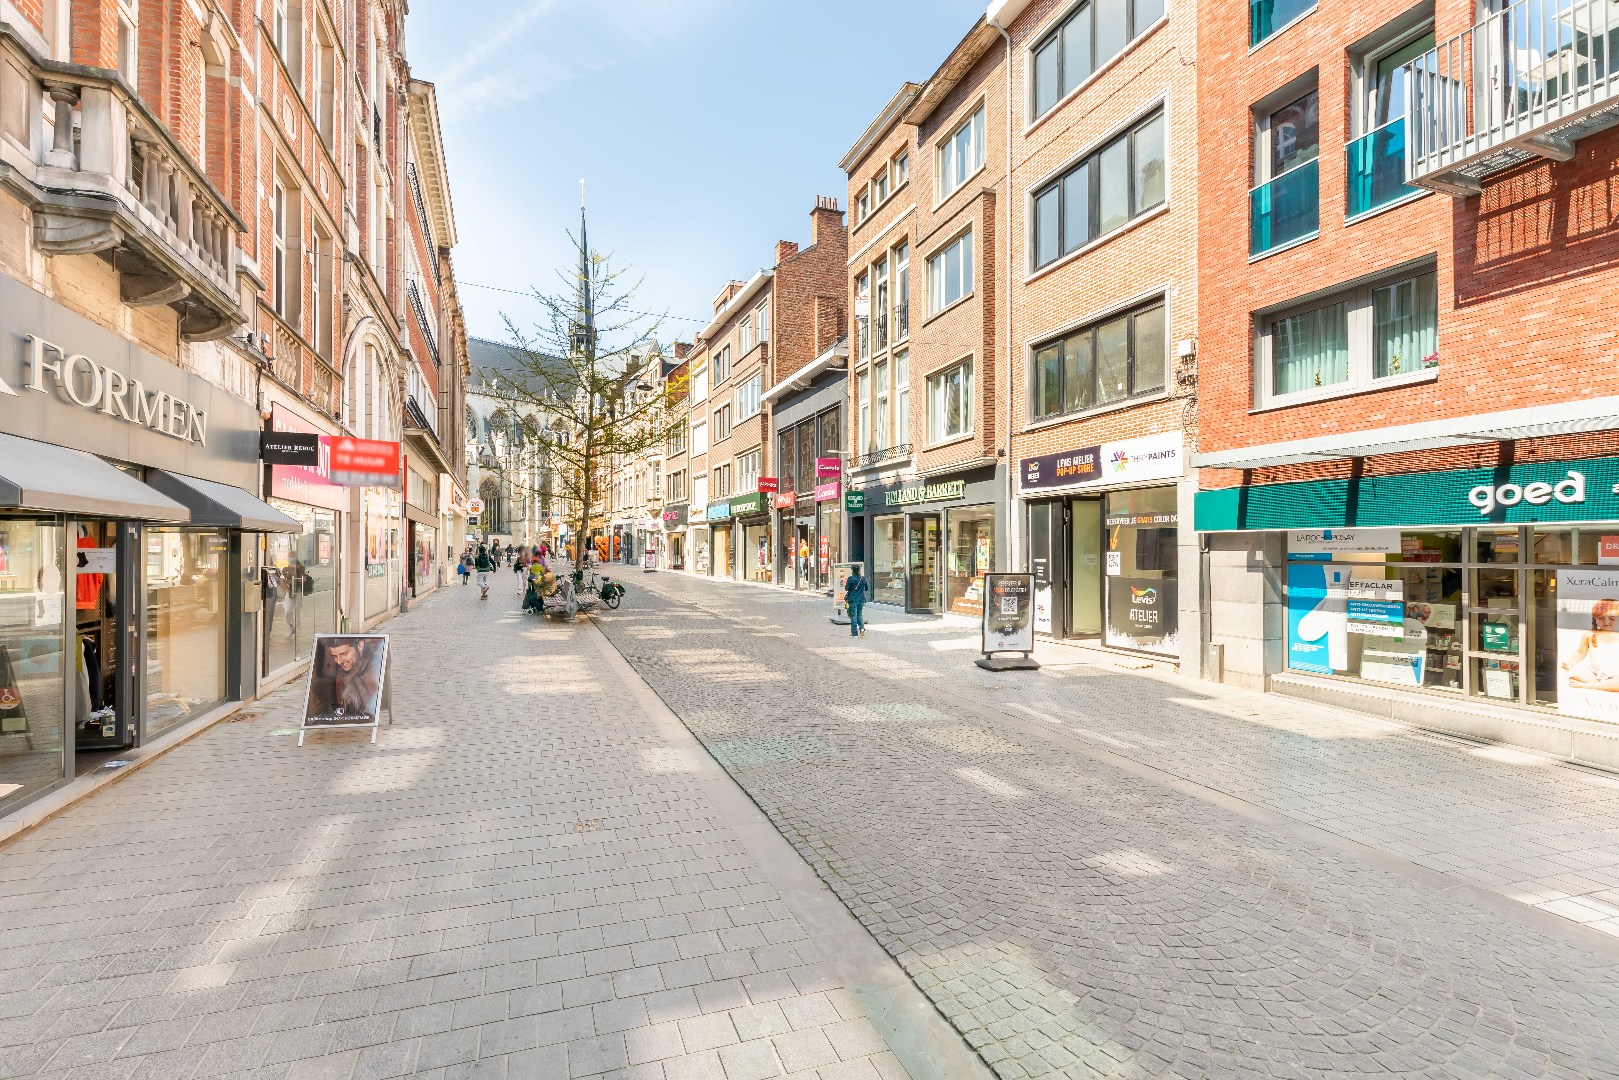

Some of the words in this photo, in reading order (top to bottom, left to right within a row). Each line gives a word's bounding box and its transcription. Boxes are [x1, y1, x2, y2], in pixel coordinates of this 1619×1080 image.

[25, 334, 208, 448] FORMEN
[1072, 453, 1095, 466] ATELIER
[885, 484, 919, 506] HOLLAND
[918, 485, 926, 501] &
[926, 479, 966, 499] BARRETT
[1468, 470, 1586, 515] goed
[1349, 581, 1393, 590] EFFACLAR
[1129, 608, 1159, 623] ATELIER
